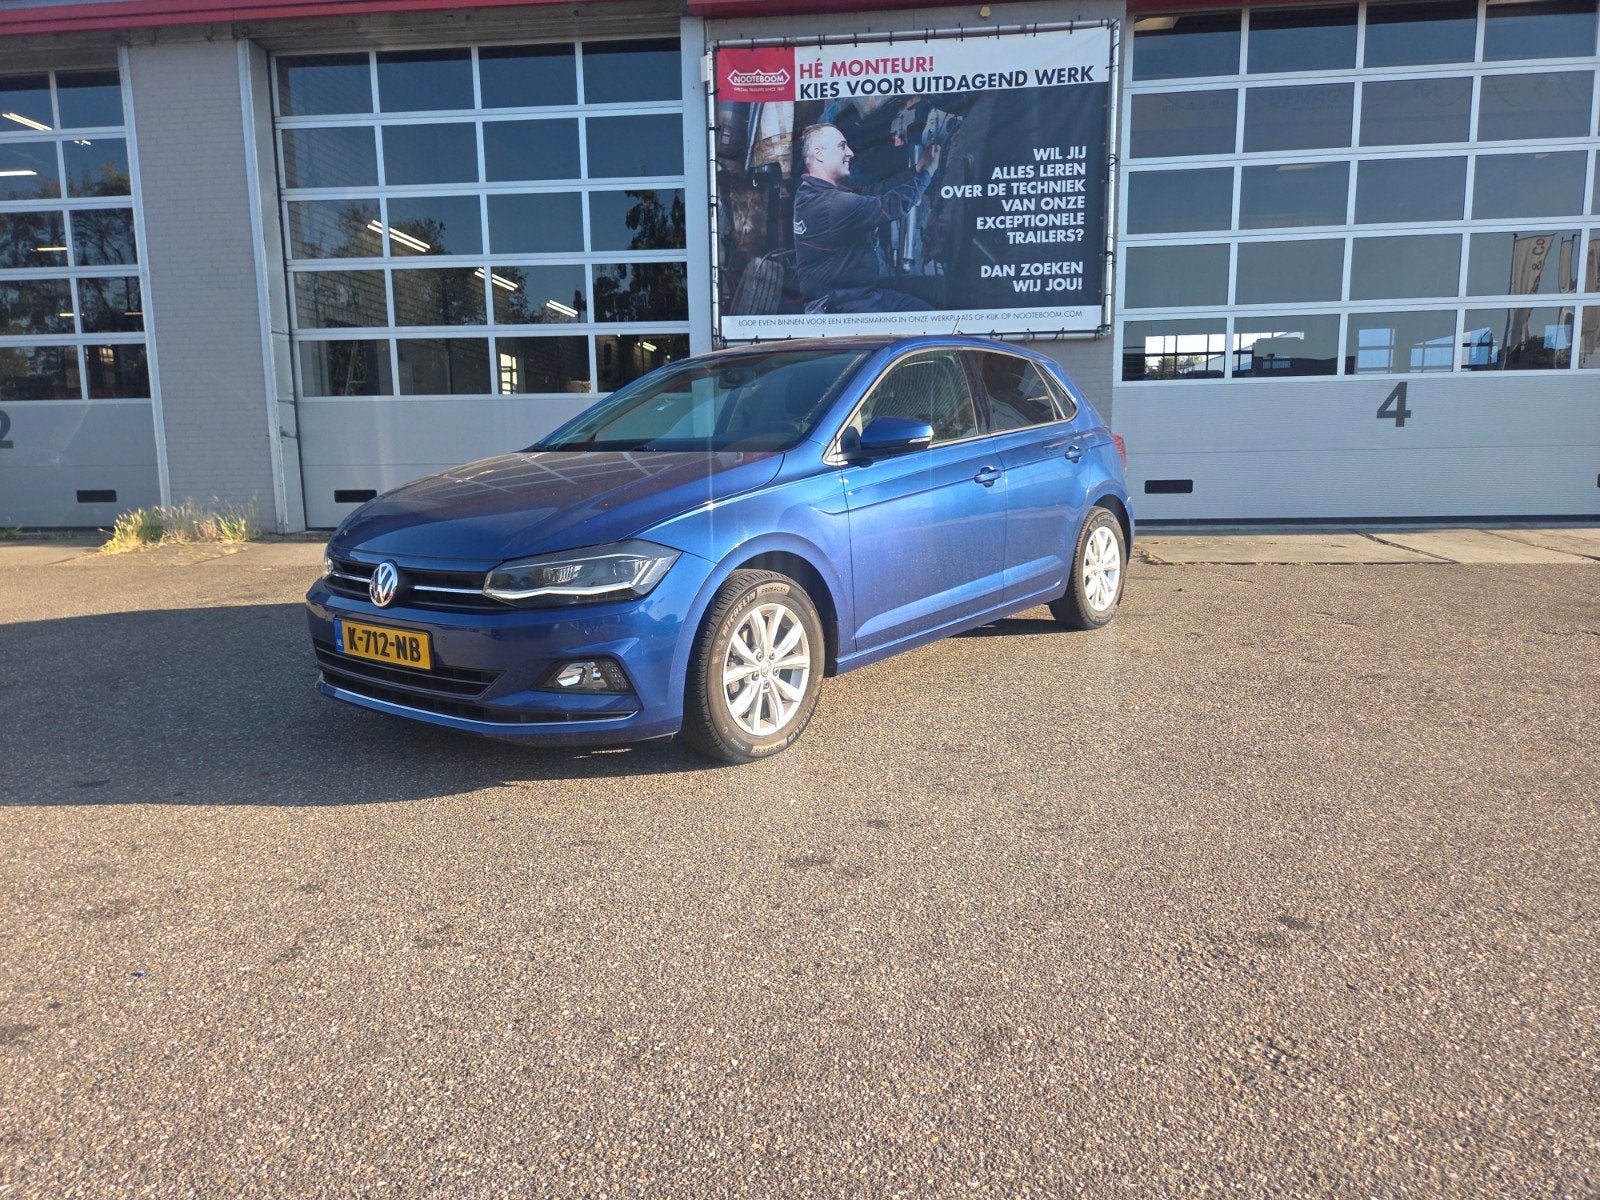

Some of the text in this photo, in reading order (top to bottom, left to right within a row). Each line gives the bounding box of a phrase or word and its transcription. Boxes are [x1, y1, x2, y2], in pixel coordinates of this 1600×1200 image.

[800, 56, 934, 79] HÉ MONTEUR!
[733, 75, 784, 83] NOOTEBOOM
[800, 65, 1094, 99] KIES VOOR UITDAGEND WERK
[1033, 145, 1087, 161] WIL JIJ
[990, 162, 1086, 180] ALLES LEREN
[940, 179, 1086, 199] OVER DE TECHNIEK
[1001, 196, 1086, 212] VAN ONZE
[976, 212, 1085, 230] EXCEPTIONELE
[1007, 228, 1085, 245] TRAILERS?
[980, 261, 1084, 278] DAN ZOEKEN
[1012, 277, 1083, 292] WIJ JOU!
[738, 319, 757, 327] LOOP
[777, 318, 805, 326] BINNEN
[828, 317, 842, 325] EEN
[843, 316, 897, 324] KENNISMAKING
[908, 315, 928, 323] ONZE
[974, 313, 984, 321] OF
[1001, 312, 1011, 320] OP
[1013, 310, 1083, 320] NOOTEBOOM.COM
[1376, 381, 1412, 428] 4
[721, 591, 757, 637] MICHELIN
[347, 627, 421, 662] K-712-NB
